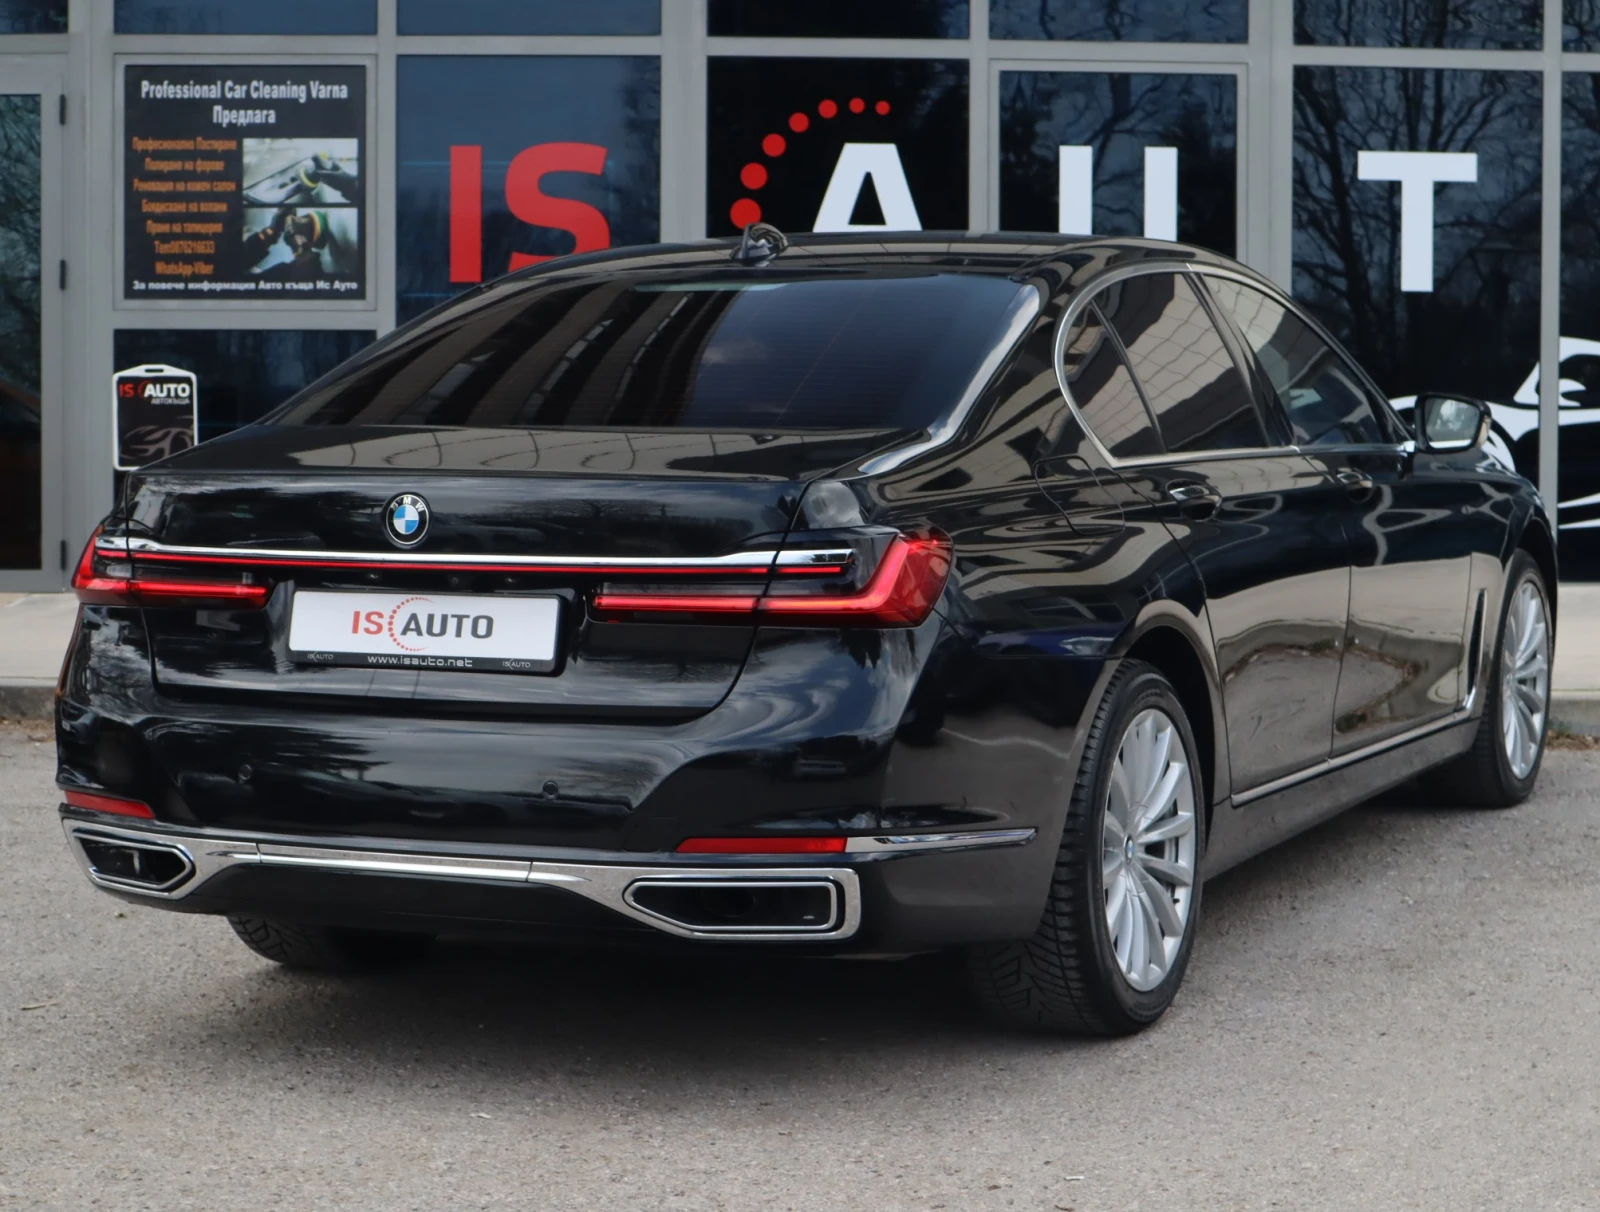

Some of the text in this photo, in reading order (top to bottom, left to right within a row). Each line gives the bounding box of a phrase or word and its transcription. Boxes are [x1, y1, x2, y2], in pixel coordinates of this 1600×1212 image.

[141, 80, 348, 103] Professional Car Cleaning Varna
[213, 105, 276, 127] Предлага
[449, 142, 611, 283] IS
[132, 280, 146, 290] За
[148, 281, 185, 290] повече
[187, 280, 256, 292] информация
[258, 280, 283, 290] Авто
[332, 280, 358, 292] Ауто
[118, 383, 191, 398] IS AUTO
[390, 496, 425, 513] BMW
[351, 610, 494, 639] IS AUTO
[367, 654, 473, 668] www.isauto.net
[511, 660, 531, 668] AUTO
